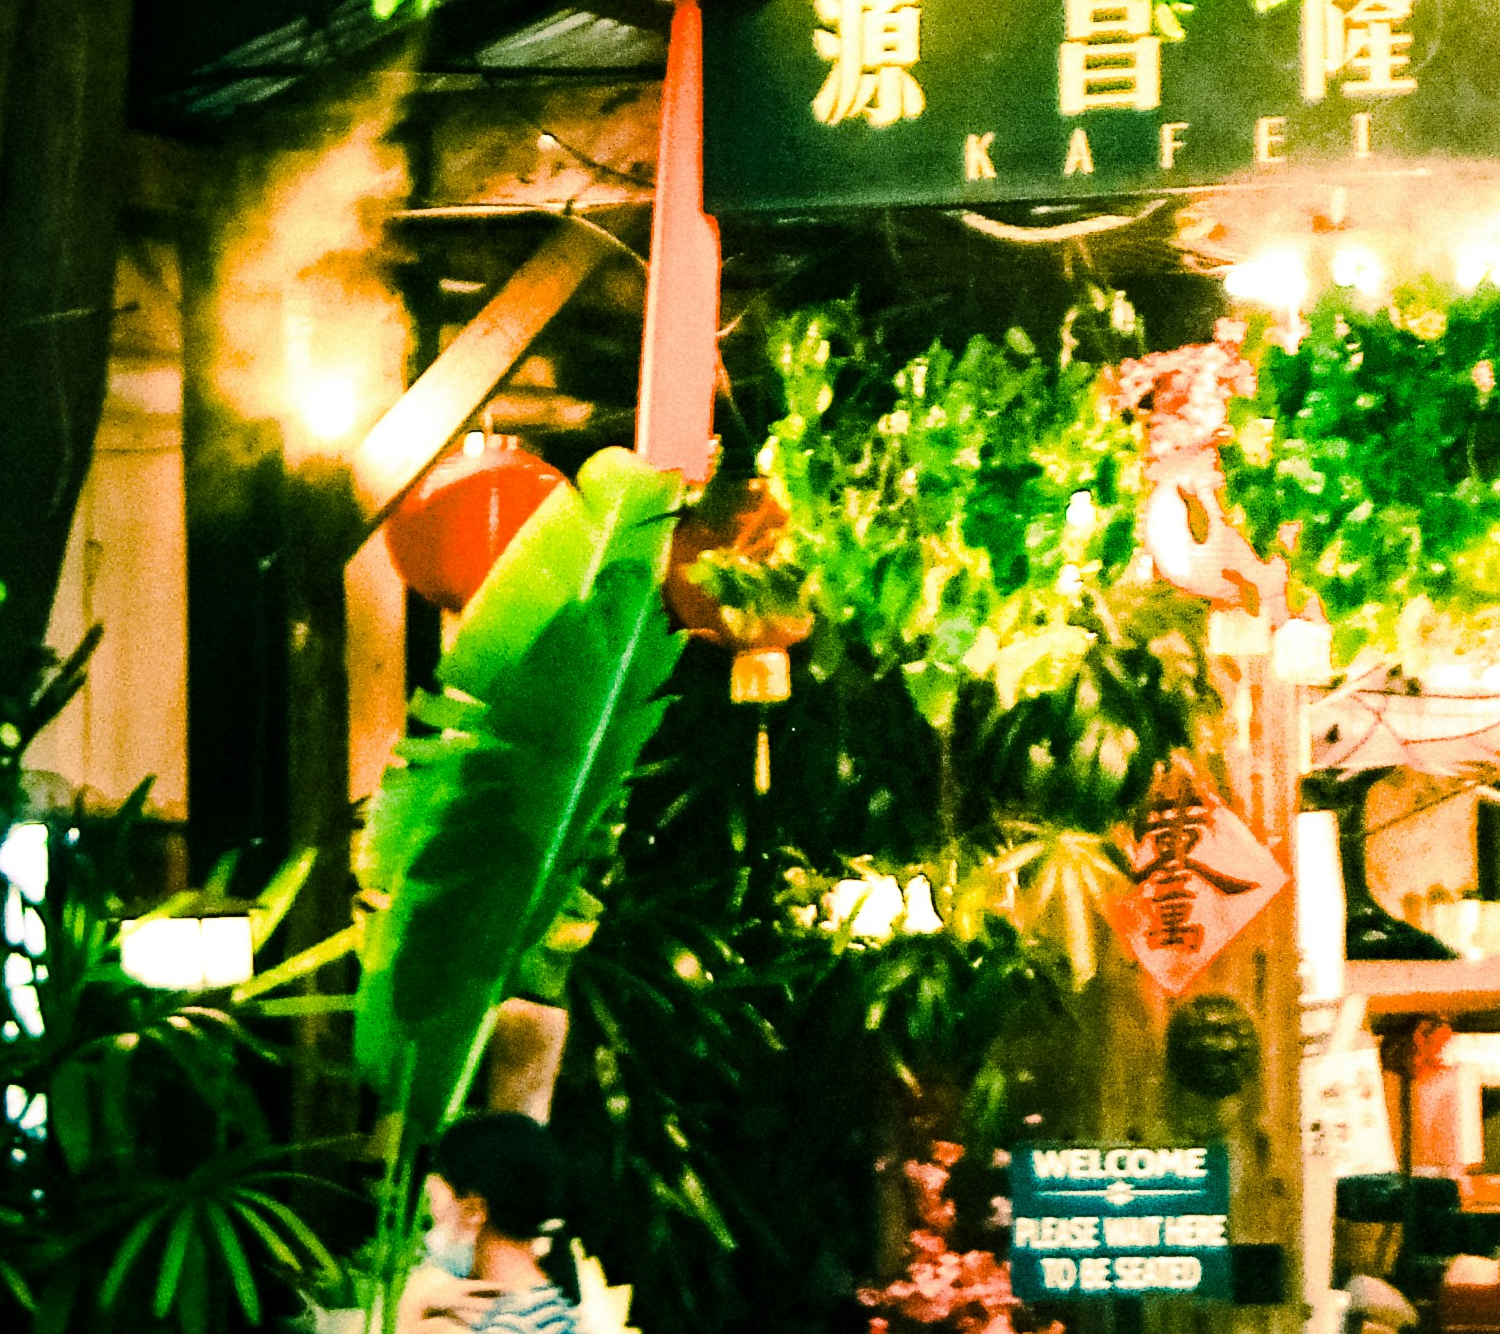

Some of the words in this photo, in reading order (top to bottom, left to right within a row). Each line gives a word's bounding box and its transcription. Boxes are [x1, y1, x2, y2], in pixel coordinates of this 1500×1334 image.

[964, 113, 1373, 180] KAFEI
[1032, 1147, 1208, 1179] WELCOME
[1015, 1216, 1100, 1249] PLEASE
[1164, 1214, 1229, 1247] HERE
[1040, 1257, 1077, 1290] TO
[1079, 1257, 1112, 1290] BE
[1113, 1256, 1202, 1289] SEATED
